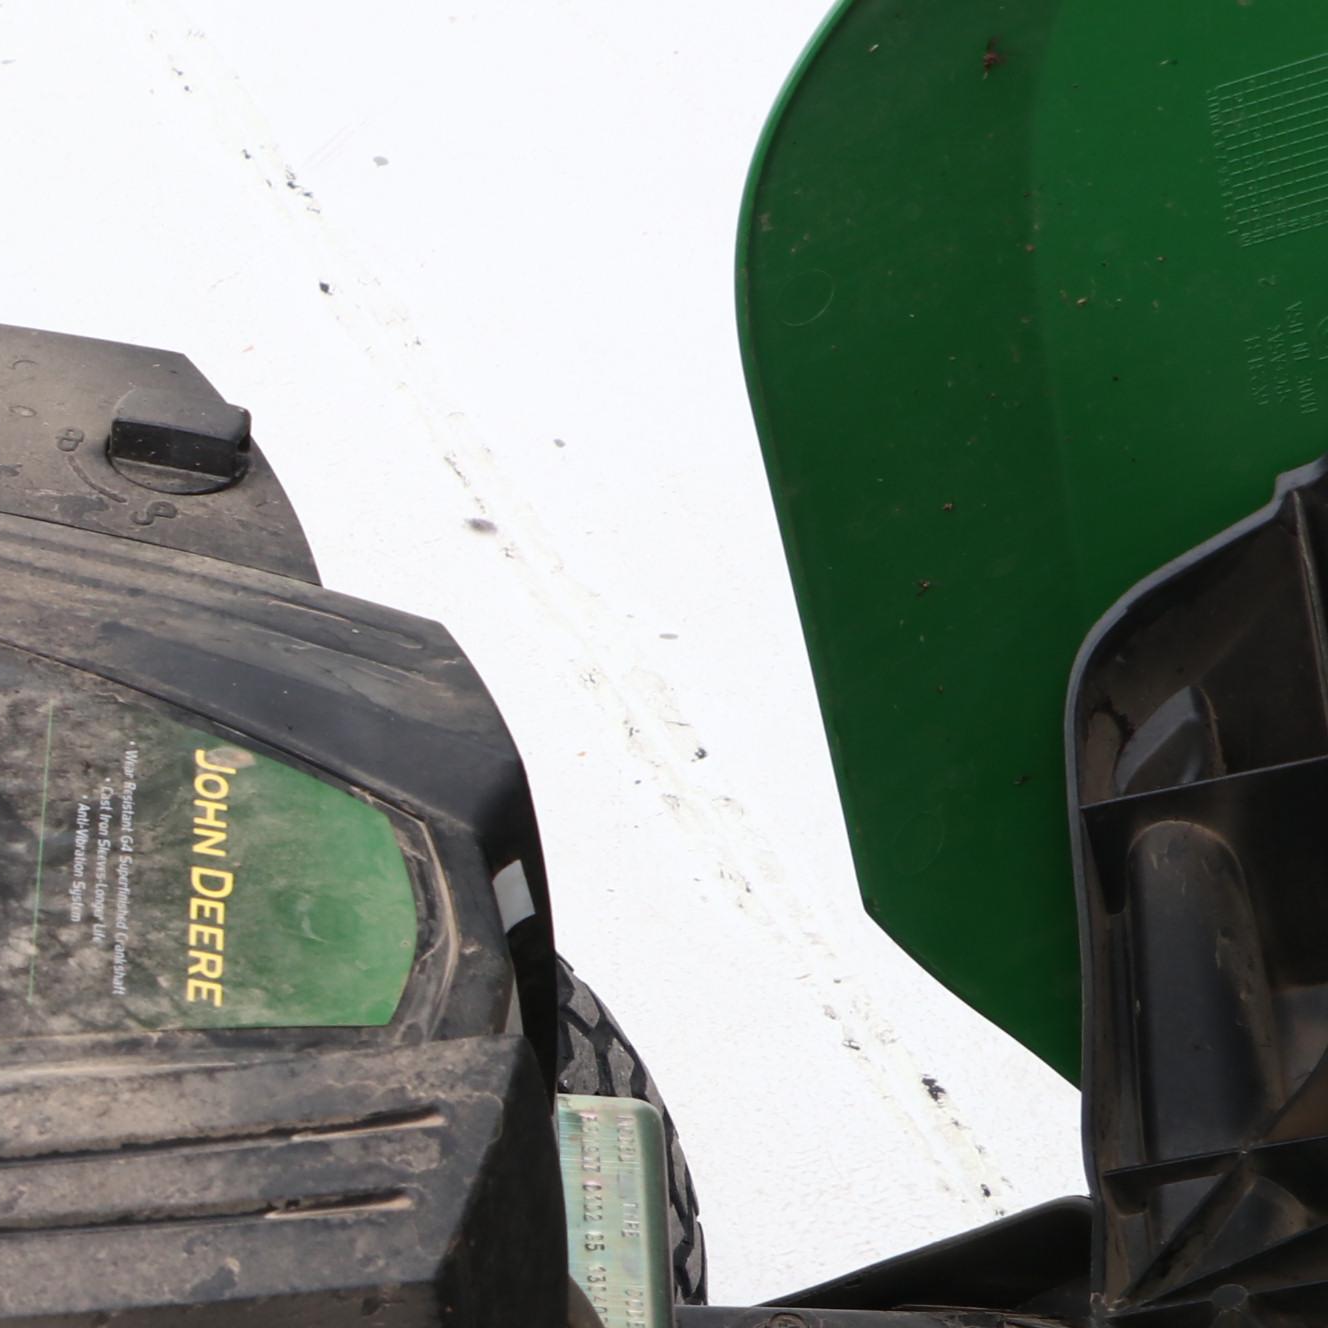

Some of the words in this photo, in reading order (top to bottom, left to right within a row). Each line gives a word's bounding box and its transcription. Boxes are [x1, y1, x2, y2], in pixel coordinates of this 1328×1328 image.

[123, 750, 138, 776] Wear
[99, 786, 114, 811] Cast
[120, 781, 136, 832] Resistant
[193, 749, 236, 857] JOHN
[73, 803, 90, 878] Anti-Vibration
[98, 814, 112, 836] Iron
[120, 835, 134, 853] G4
[69, 881, 86, 922] System
[92, 839, 110, 921] Sleeves-Longer
[115, 856, 132, 929] Superfinished
[92, 924, 106, 943] Life
[186, 866, 233, 1007] DEERE
[112, 932, 128, 995] Crankshaft
